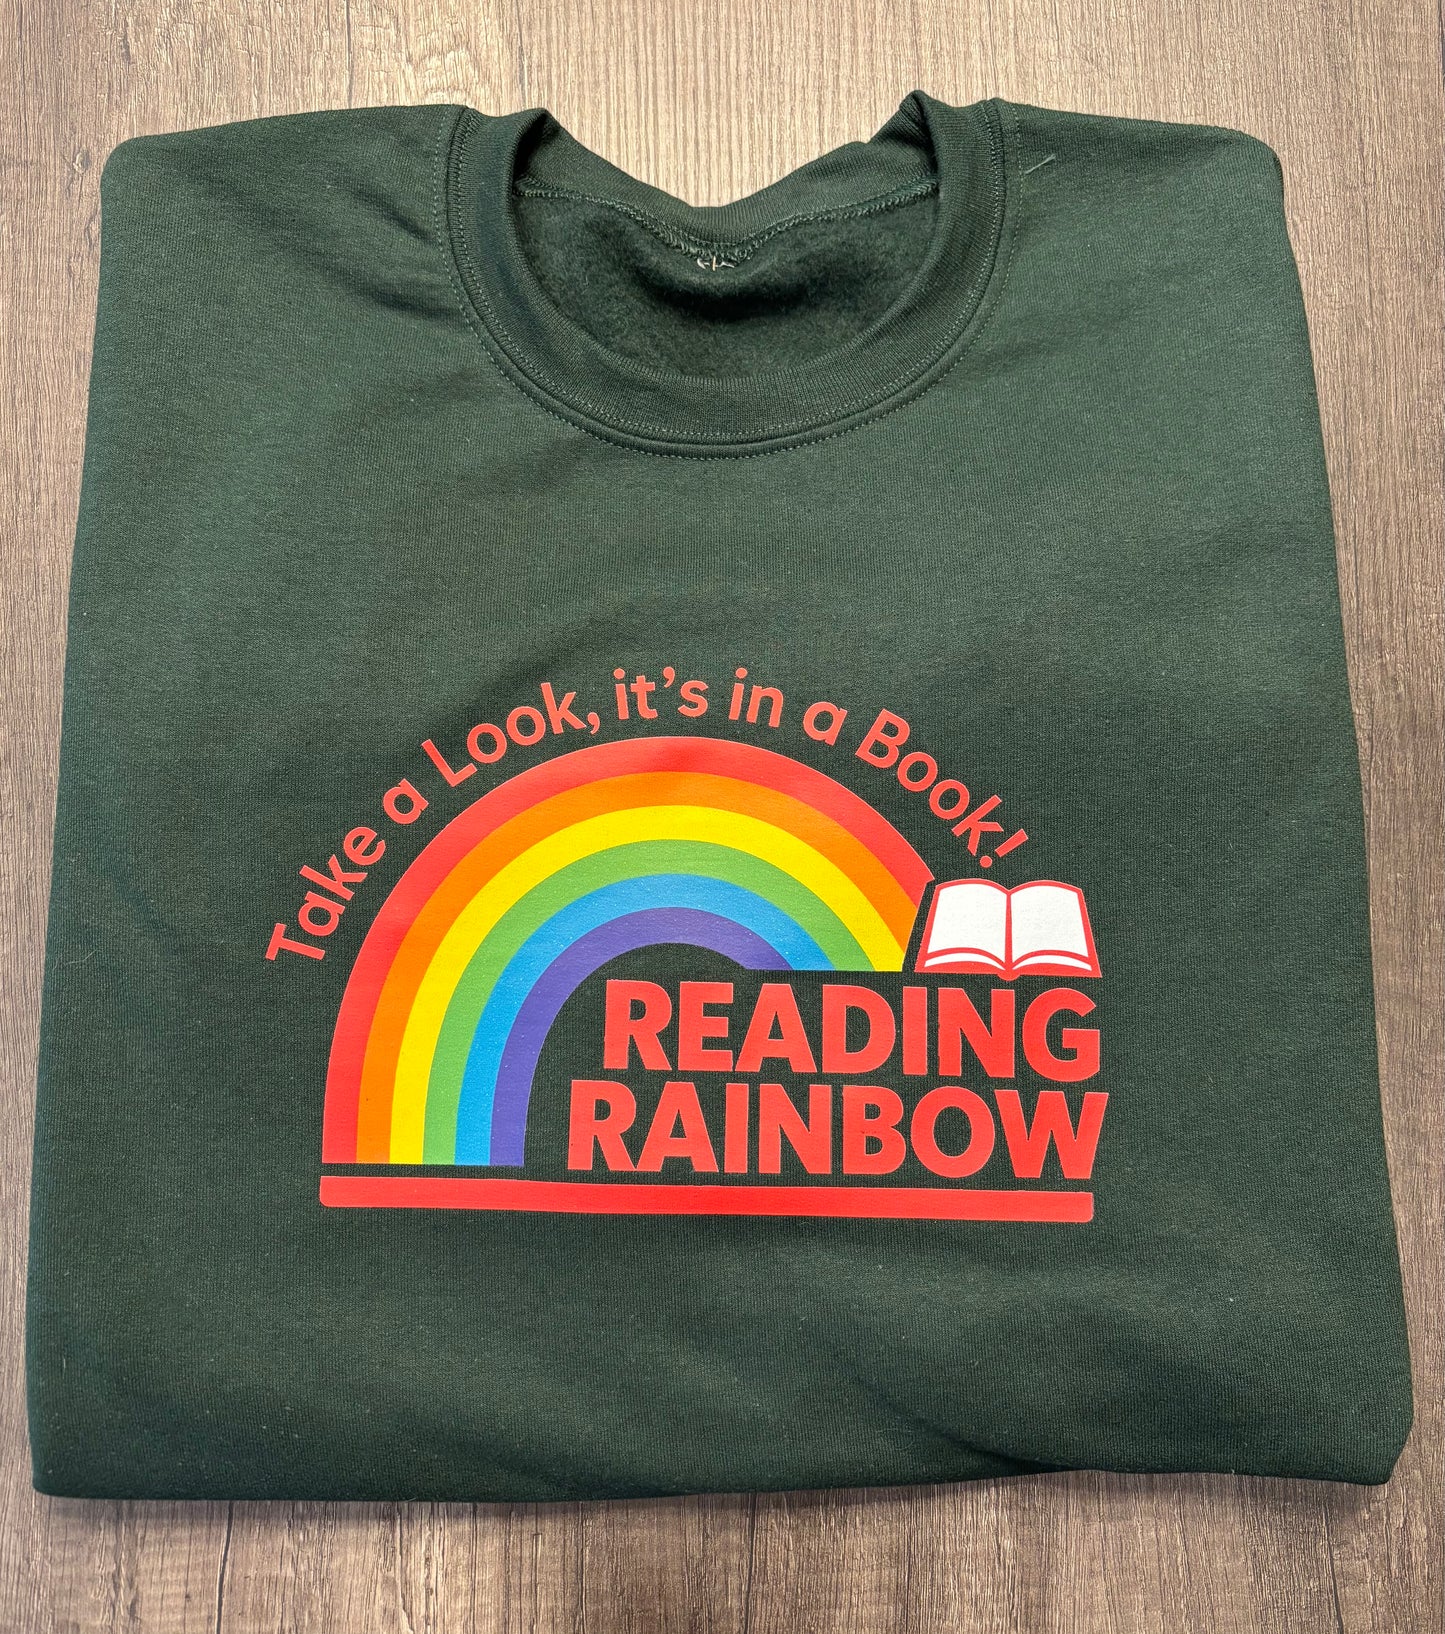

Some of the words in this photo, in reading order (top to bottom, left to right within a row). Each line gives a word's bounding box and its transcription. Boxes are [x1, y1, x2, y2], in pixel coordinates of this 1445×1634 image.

[264, 826, 386, 961] Take
[382, 779, 429, 825] a
[422, 683, 600, 788] Look,
[728, 668, 783, 728] in
[802, 702, 848, 746] a
[855, 709, 1028, 869] Book!
[602, 980, 1101, 1083] READING
[567, 1079, 1109, 1181] RAINBOW
